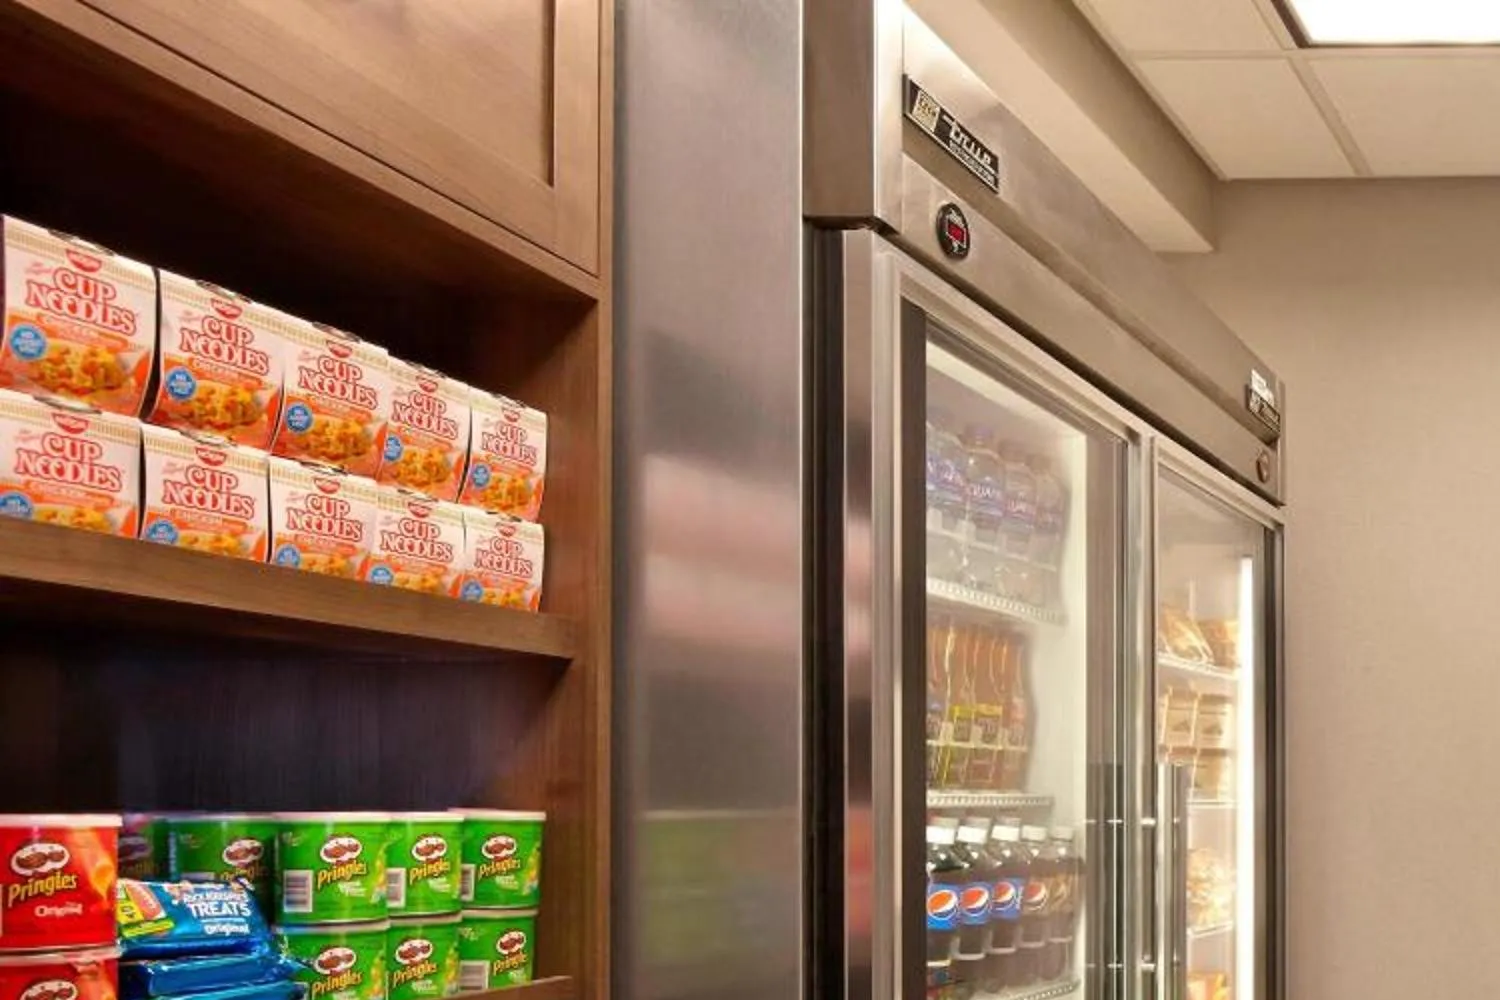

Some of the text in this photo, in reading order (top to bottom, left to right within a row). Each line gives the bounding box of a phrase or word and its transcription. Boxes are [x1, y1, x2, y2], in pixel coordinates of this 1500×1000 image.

[54, 267, 117, 300] CUP
[26, 280, 137, 336] NOODLES
[202, 315, 254, 346] CUP
[180, 328, 270, 376] NOODLES
[318, 355, 362, 382] CUP
[408, 390, 447, 415] CUP
[496, 421, 528, 443] CUP
[42, 432, 103, 462] CUP
[14, 448, 123, 492] NOODLES
[185, 465, 240, 491] CUP
[162, 480, 256, 520] NOODLES
[305, 494, 351, 518] CUP
[399, 517, 441, 540] CUP
[490, 536, 523, 557] CUP
[317, 862, 368, 891] Pringles
[478, 858, 521, 881] Pringles
[8, 872, 78, 908] Pringles
[188, 901, 252, 918] TREATS
[312, 971, 362, 999] Pringles
[392, 960, 437, 989] Pringles
